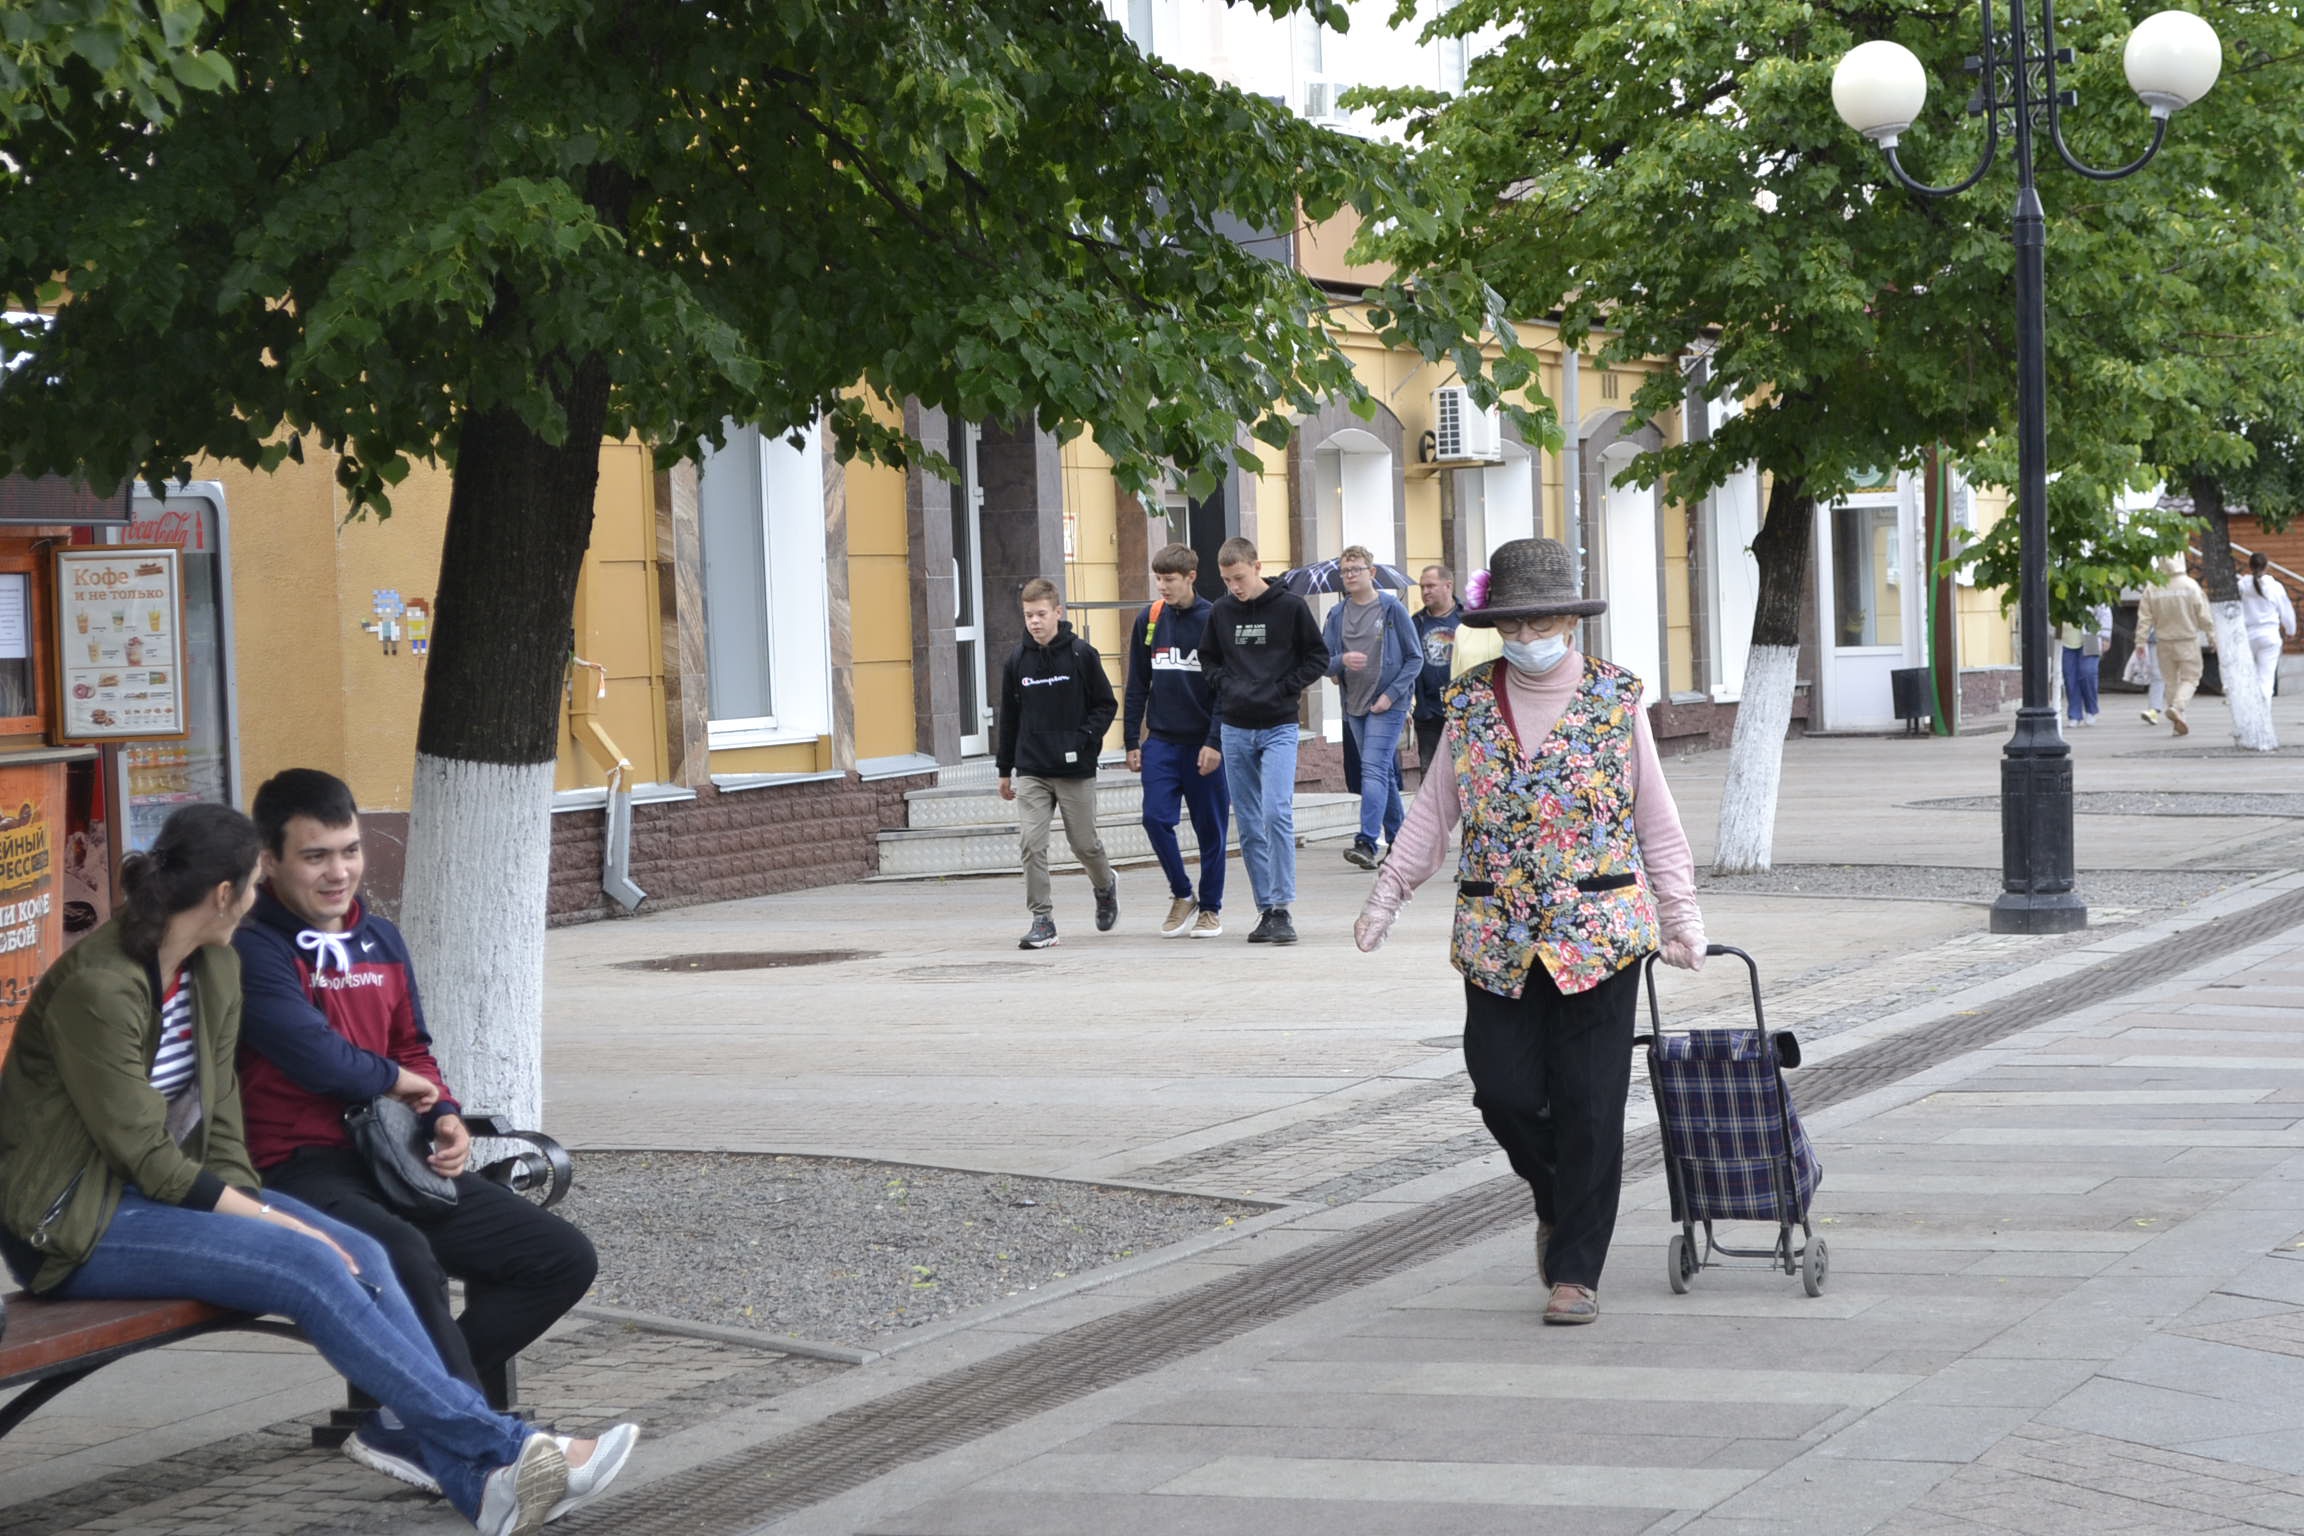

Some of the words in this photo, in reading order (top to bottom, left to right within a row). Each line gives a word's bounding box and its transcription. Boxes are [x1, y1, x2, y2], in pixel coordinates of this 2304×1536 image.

[72, 566, 129, 589] Кофе
[74, 591, 85, 601] и
[89, 591, 107, 600] не
[111, 589, 164, 600] только
[1155, 647, 1201, 666] FILA
[0, 827, 45, 859] ЙНЫЙ
[17, 893, 51, 922] КОФЕ
